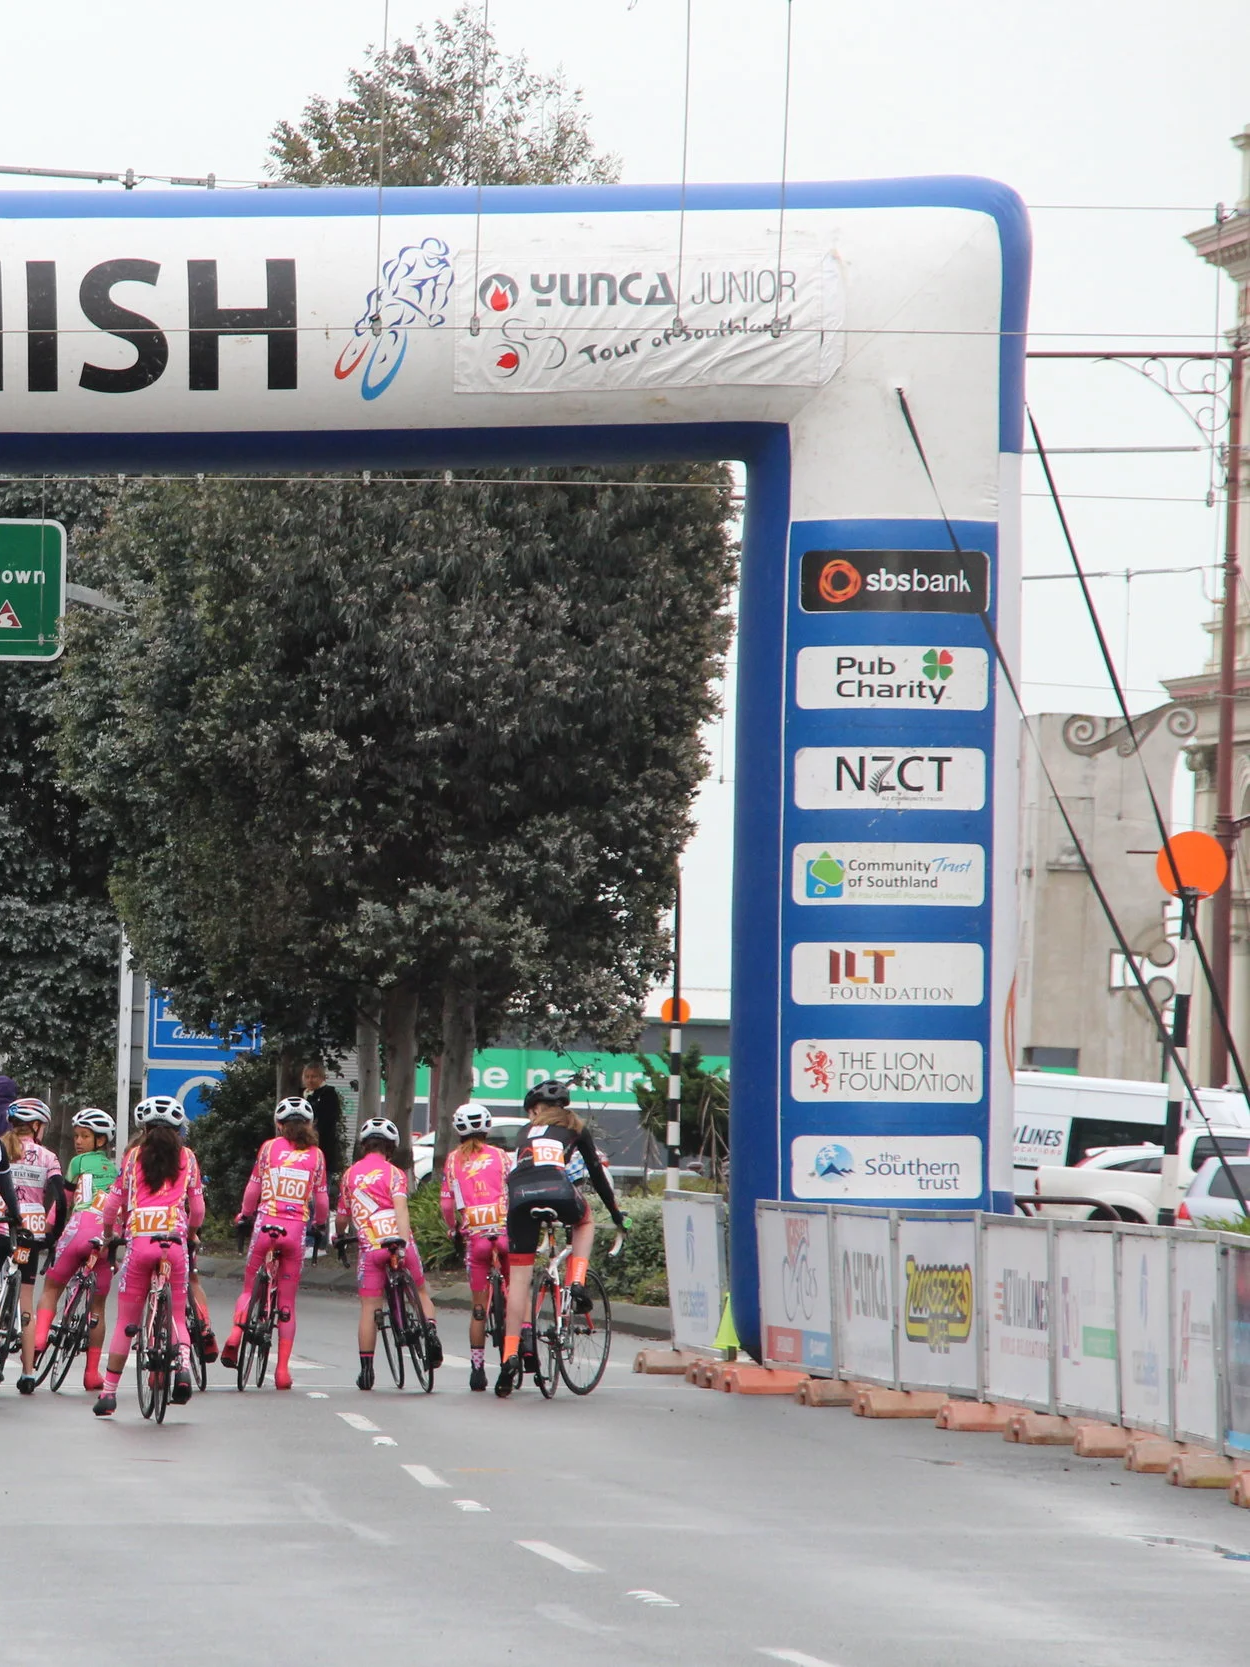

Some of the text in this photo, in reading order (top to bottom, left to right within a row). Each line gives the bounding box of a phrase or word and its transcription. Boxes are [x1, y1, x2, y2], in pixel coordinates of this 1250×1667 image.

[530, 269, 797, 307] YUNCA JUNIOR
[578, 314, 792, 365] Tour of Southland
[836, 657, 896, 676] Pub
[836, 680, 947, 705] Charity
[836, 755, 953, 796] NZCT
[848, 857, 972, 875] Community Trust
[848, 876, 938, 889] of Southland
[829, 949, 896, 984] ILT
[830, 986, 954, 1001] FOUNDATION
[839, 1052, 934, 1071] THE LION
[839, 1073, 974, 1092] FOUNDATION
[536, 1148, 560, 1161] 167
[879, 1152, 901, 1163] the
[865, 1158, 960, 1176] Southern
[280, 1179, 306, 1198] 160
[918, 1176, 959, 1190] trust
[23, 1215, 46, 1232] 166
[137, 1212, 168, 1230] 172
[471, 1207, 497, 1225] 171
[374, 1218, 399, 1236] 162
[853, 1251, 889, 1320] YUNCA
